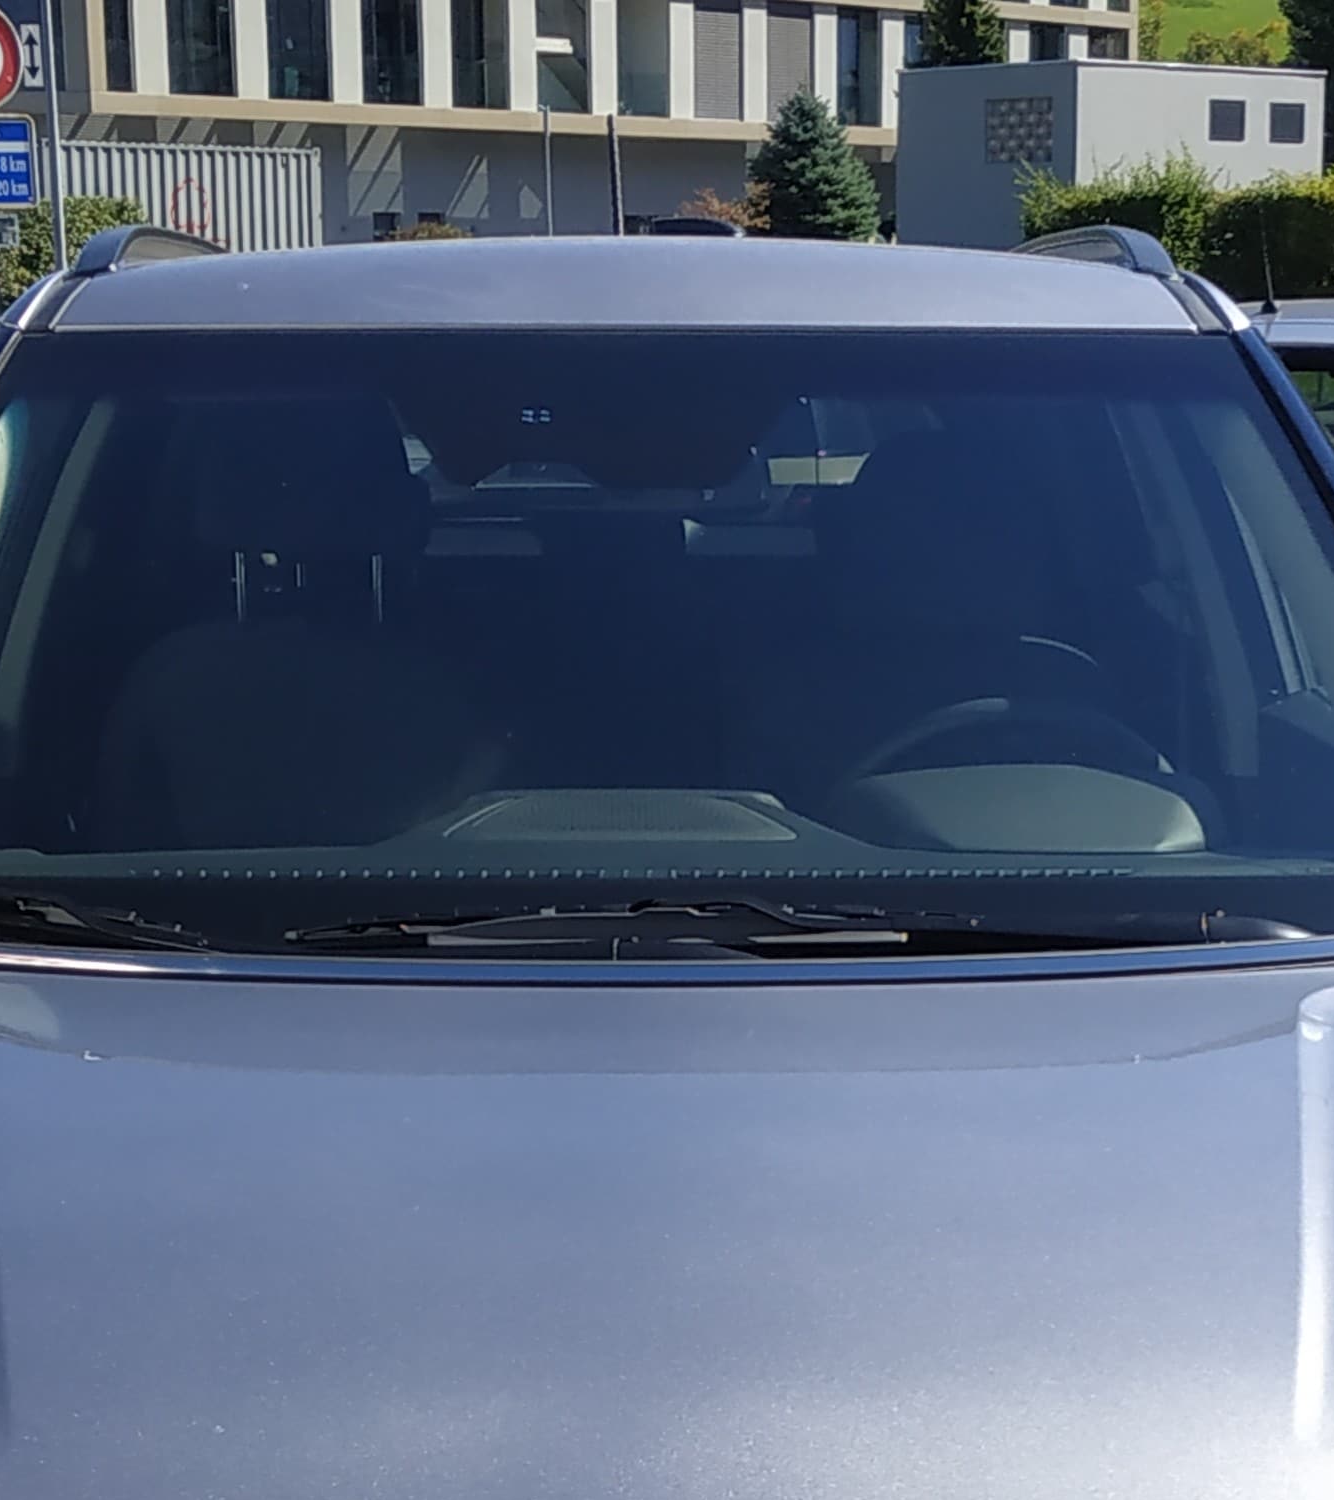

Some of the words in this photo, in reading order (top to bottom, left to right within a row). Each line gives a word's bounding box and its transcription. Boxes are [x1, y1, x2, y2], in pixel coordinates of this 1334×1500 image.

[0, 156, 8, 173] 8
[9, 155, 27, 173] km
[11, 178, 29, 196] km
